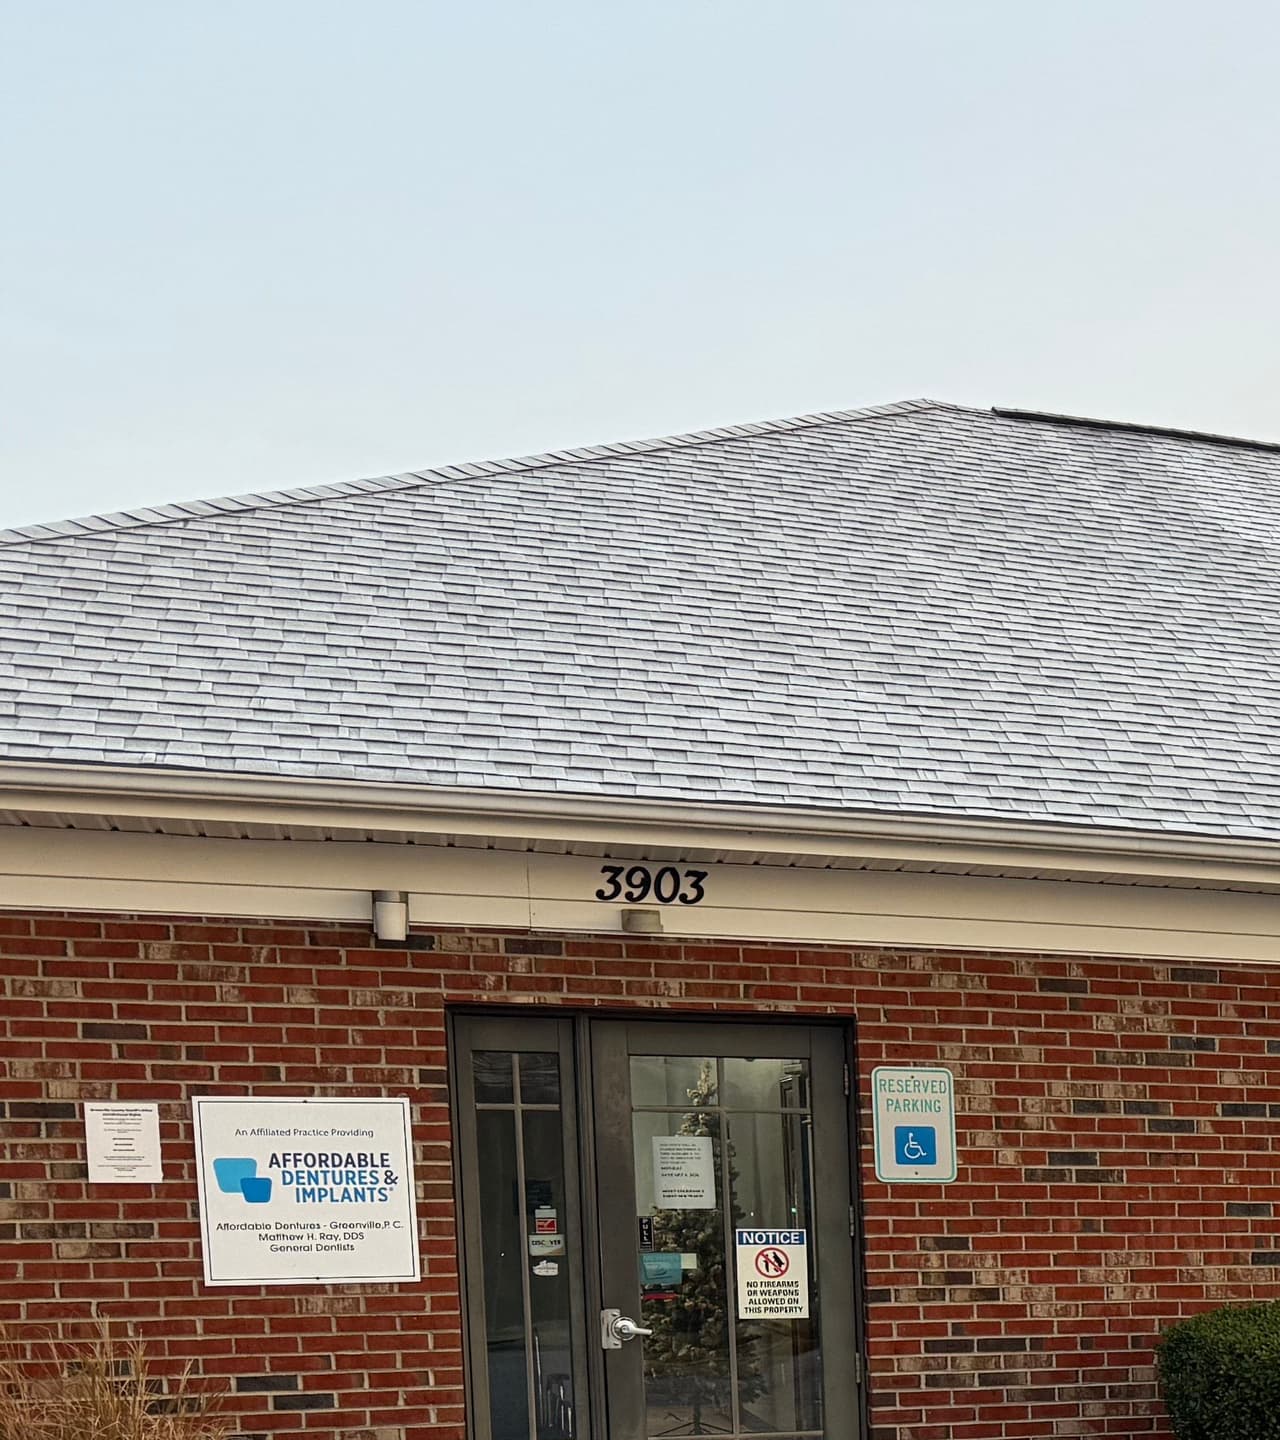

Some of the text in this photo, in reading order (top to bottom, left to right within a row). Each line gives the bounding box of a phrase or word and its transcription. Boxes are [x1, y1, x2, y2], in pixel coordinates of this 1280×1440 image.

[595, 865, 709, 905] 3903
[879, 1078, 947, 1094] RESERVED
[886, 1098, 942, 1113] PARKING
[235, 1128, 374, 1138] An Affiliated Practice Providing
[268, 1153, 390, 1168] AFFORDABLE
[282, 1170, 398, 1185] DENTURES &
[216, 1222, 272, 1231] Affordable
[275, 1222, 321, 1230] Dentures
[259, 1233, 304, 1241] Matthew
[307, 1233, 317, 1241] H.
[343, 1232, 365, 1240] DDS
[742, 1231, 801, 1244] NOTICE
[270, 1243, 355, 1252] General Dentists
[747, 1289, 799, 1297] OR WEAPONS
[744, 1306, 803, 1314] THIS PROPERTY
